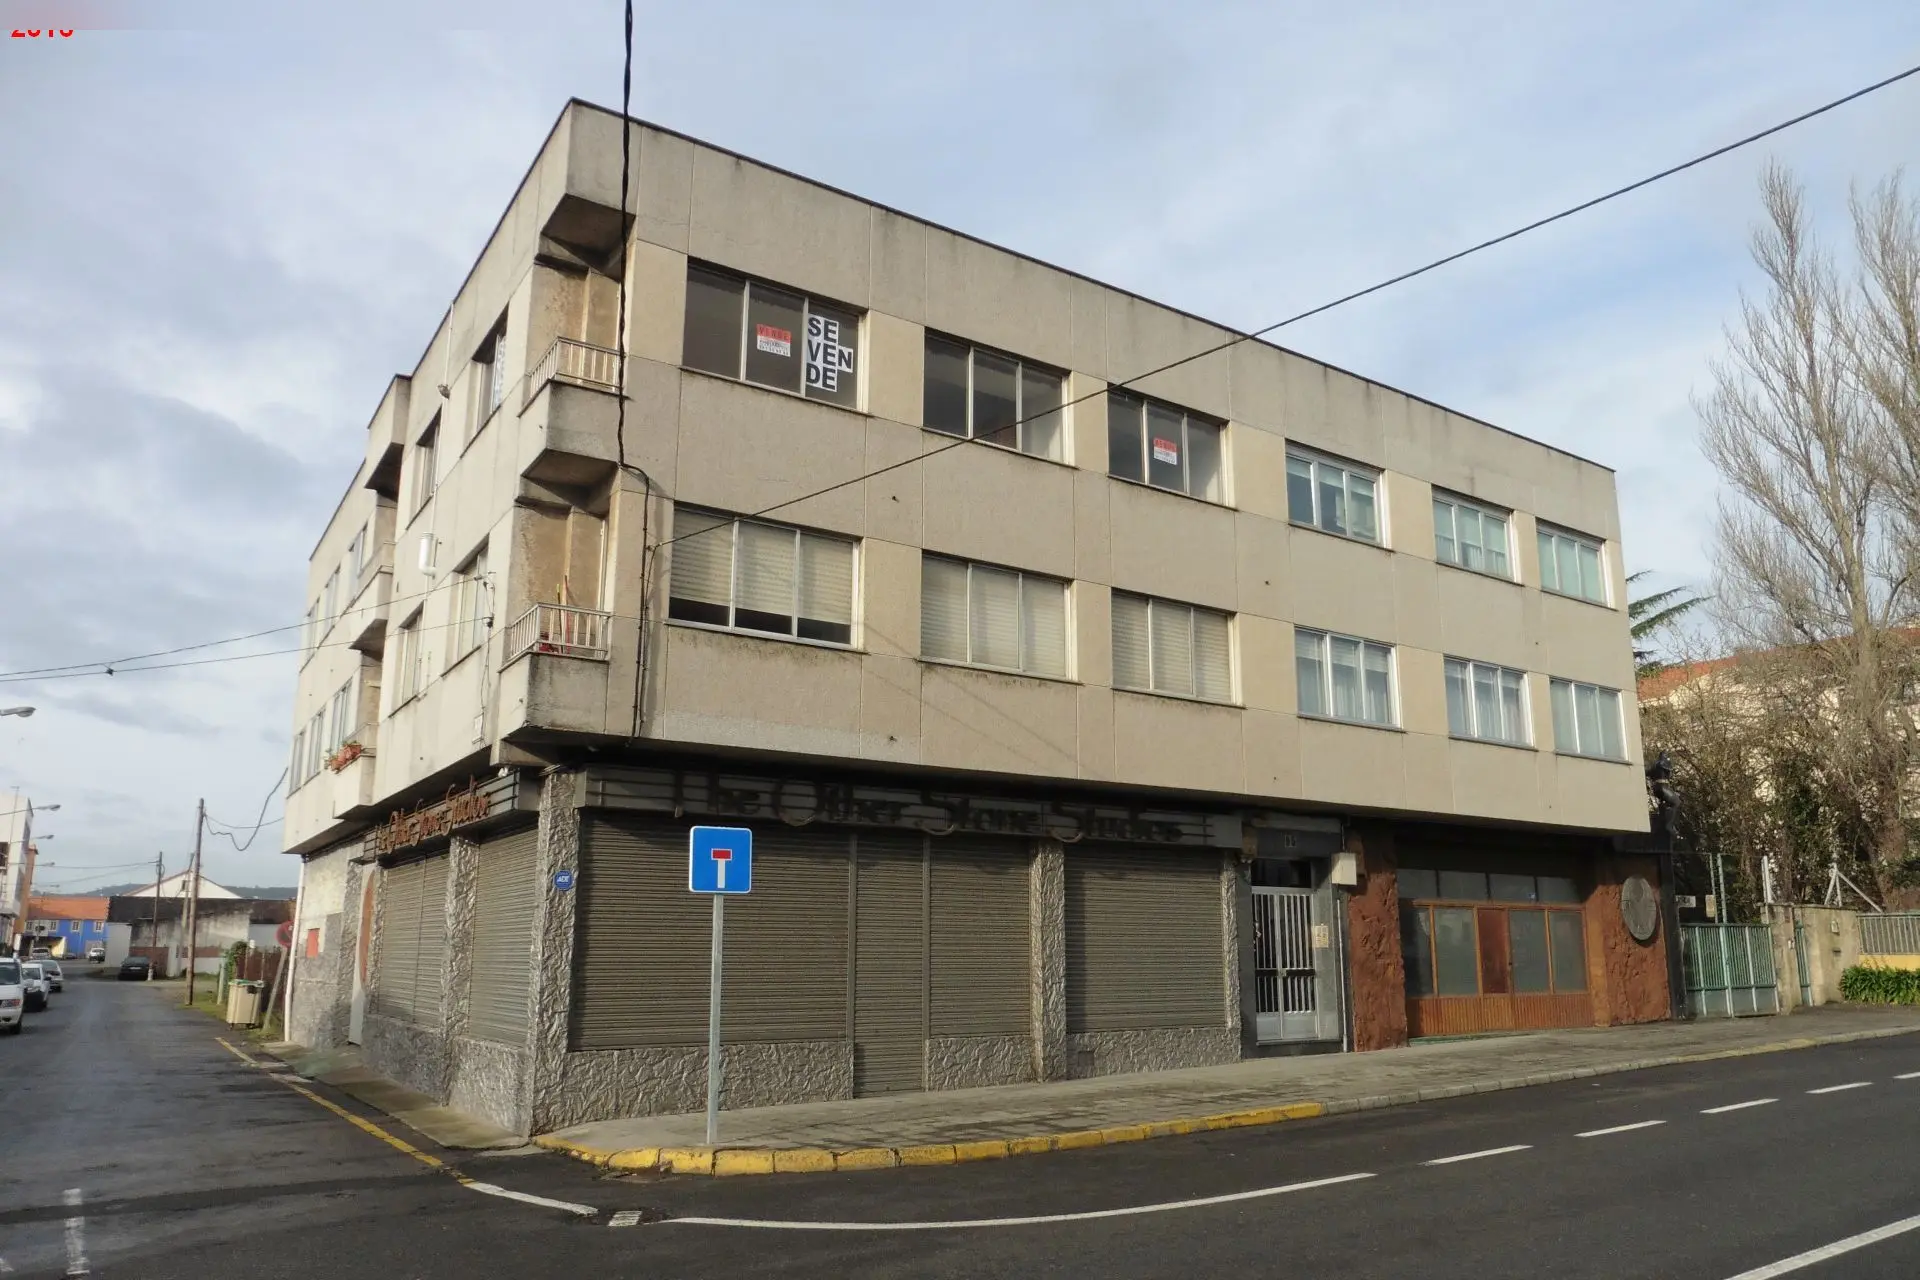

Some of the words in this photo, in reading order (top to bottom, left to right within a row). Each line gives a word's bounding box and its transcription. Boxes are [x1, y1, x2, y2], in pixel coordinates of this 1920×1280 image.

[807, 317, 838, 343] SE
[807, 339, 852, 369] VEN
[806, 362, 837, 391] DE
